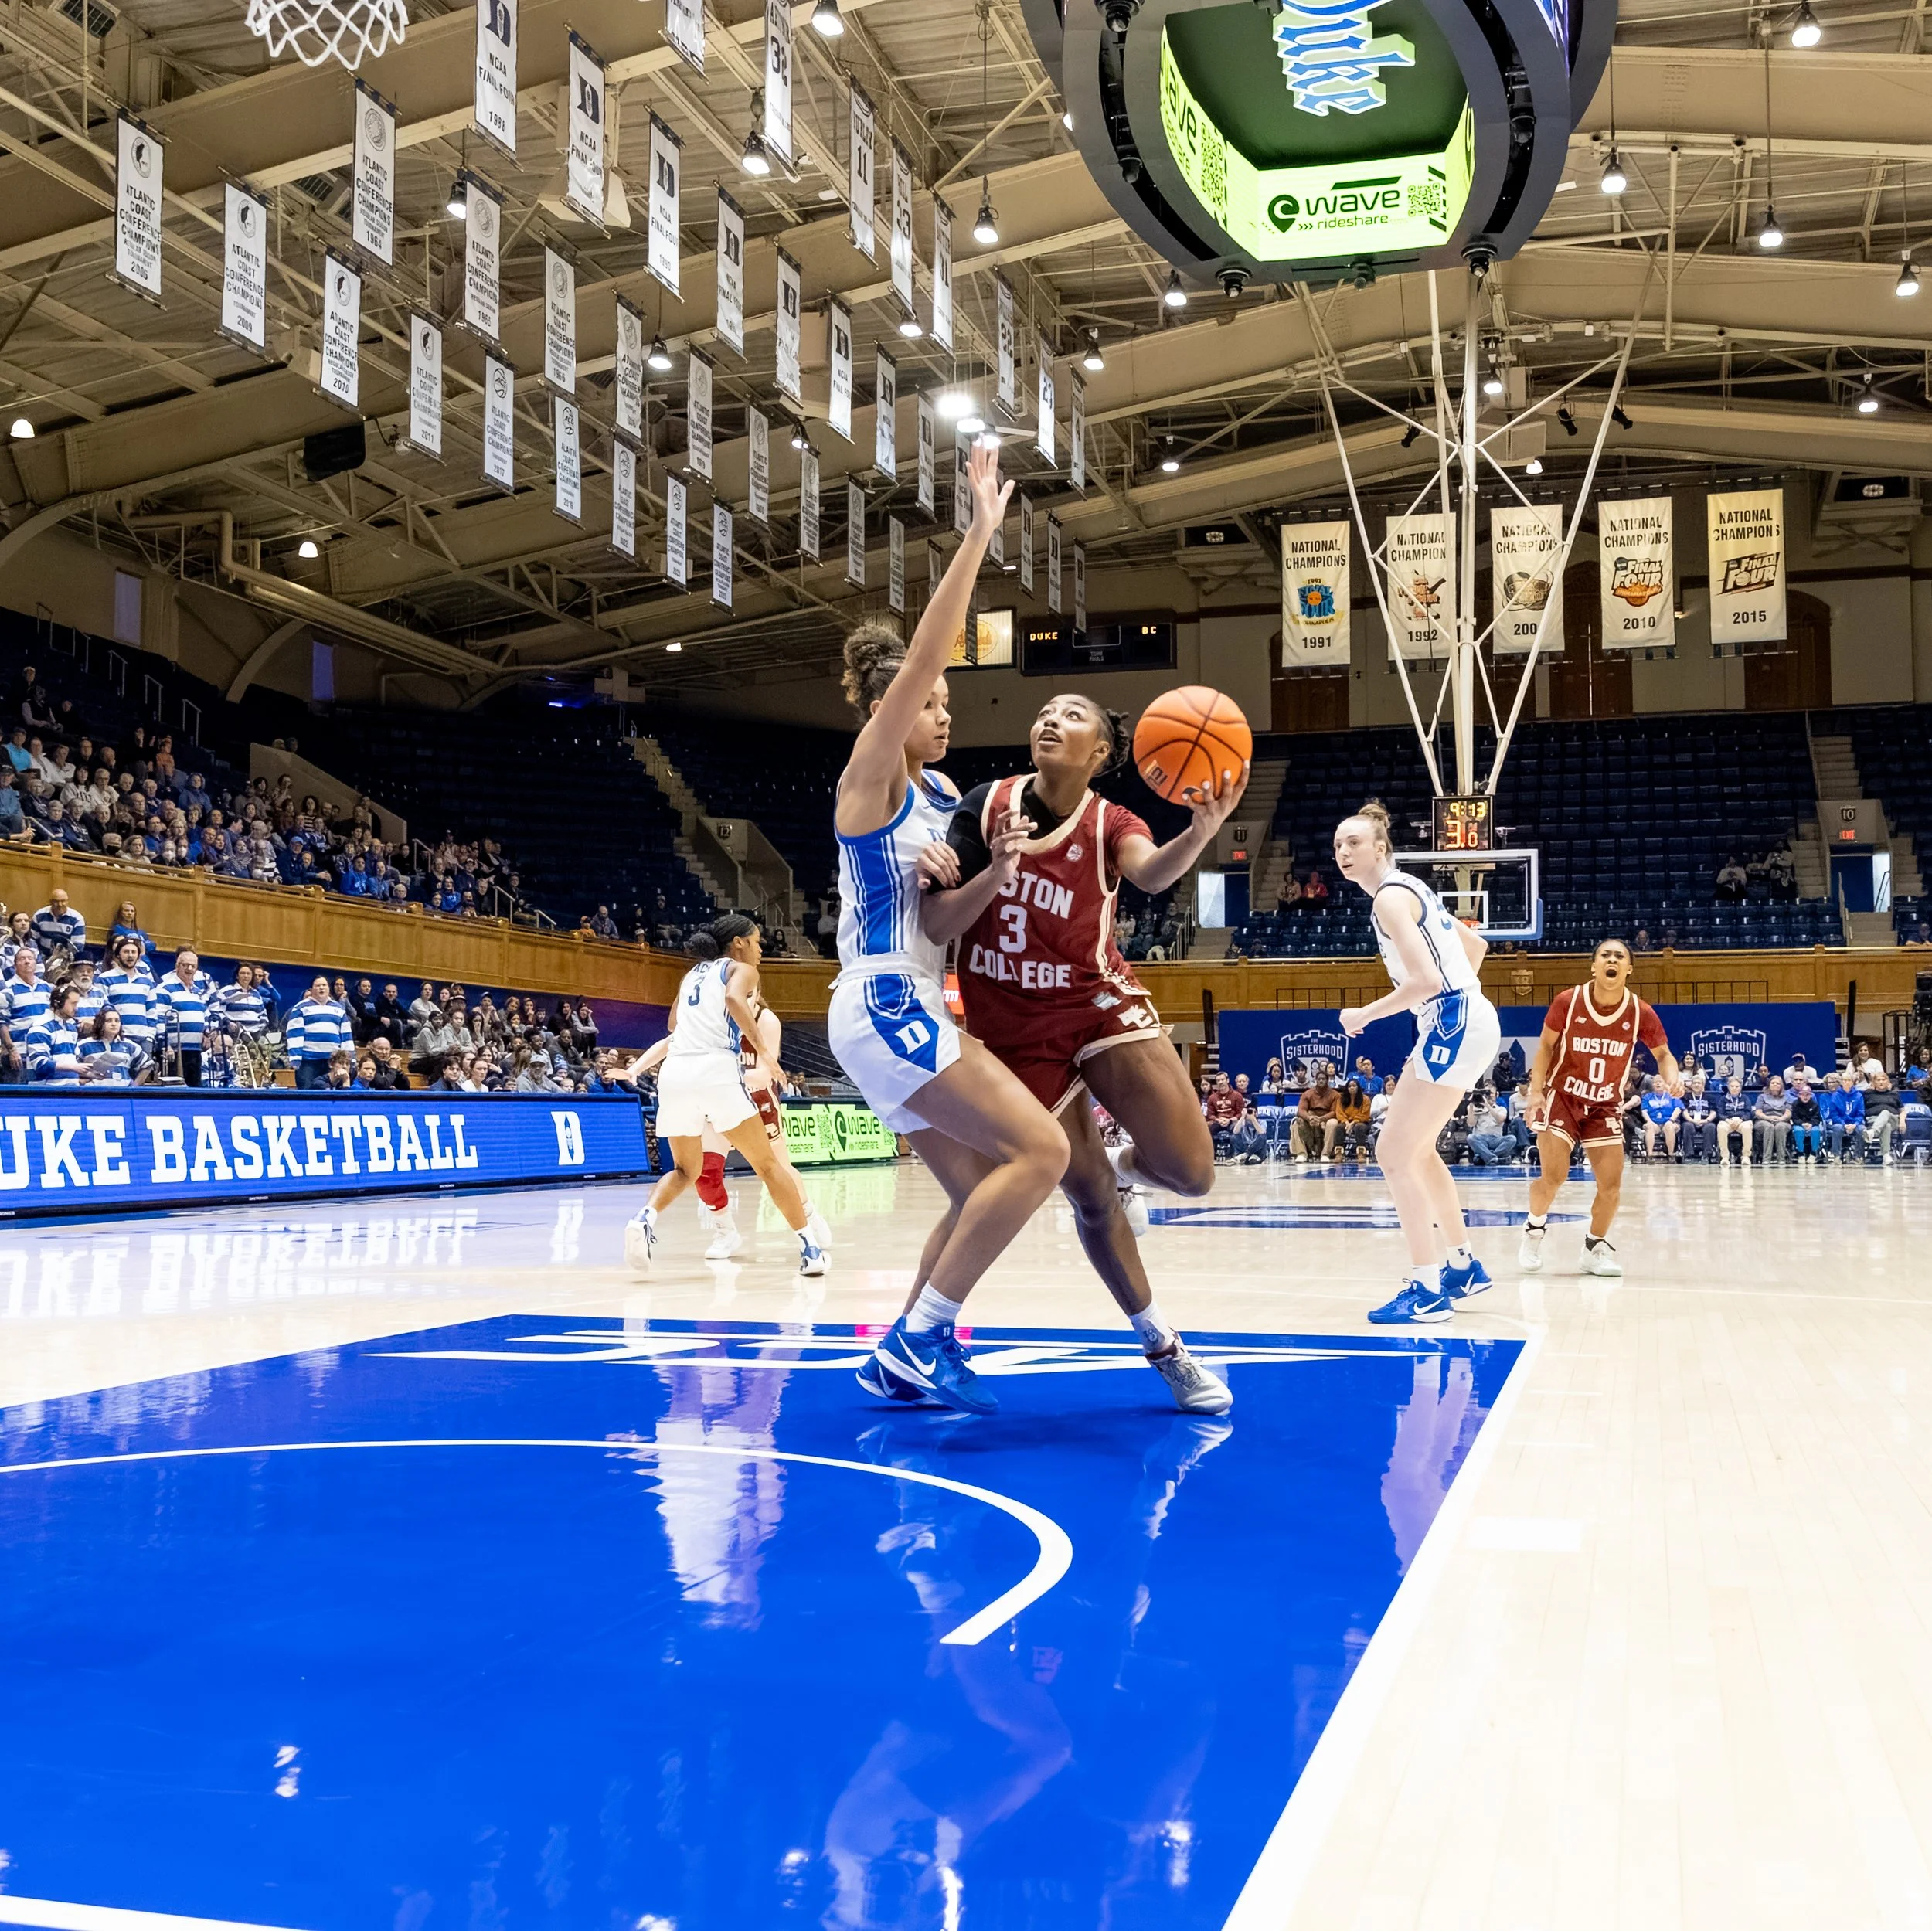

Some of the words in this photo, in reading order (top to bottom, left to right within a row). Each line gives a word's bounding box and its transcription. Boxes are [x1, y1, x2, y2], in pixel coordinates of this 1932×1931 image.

[490, 53, 506, 76] NCAA
[1272, 0, 1415, 116] uke
[479, 66, 498, 91] FINAL
[580, 131, 596, 152] NCAA
[572, 144, 587, 165] FINAL
[363, 154, 387, 181] ATLANTIC
[857, 146, 868, 185] 11
[366, 170, 384, 192] COAST
[127, 183, 155, 210] ATLANTIC
[356, 178, 392, 213] CONFERENCE
[131, 201, 151, 222] COAST
[358, 192, 390, 226] CHAMPIONS
[120, 209, 161, 242] CONFERENCE
[1318, 214, 1388, 229] rideshare
[122, 223, 158, 255] CHAMPIONS
[367, 231, 382, 249] 1964
[233, 244, 260, 267] ATLANTIC
[472, 240, 494, 263] ATLANTIC
[238, 260, 255, 278] COAST
[476, 256, 491, 273] COAST
[226, 267, 264, 297] CONFERENCE
[226, 281, 262, 309] CHAMPIONS
[553, 315, 566, 332] COAST
[333, 378, 349, 393] 2010
[488, 425, 512, 445] CONFERENC
[1610, 516, 1662, 532] NATIONAL
[1719, 508, 1772, 524] NATIONAL
[1604, 532, 1668, 548] CHAMPIONS
[1713, 525, 1780, 541] CHAMPIONS
[1292, 539, 1340, 553] NATIONAL
[1391, 548, 1446, 561] CHAMPION
[1286, 555, 1346, 569] CHAMPIONS
[1627, 560, 1663, 574] FINAL
[1741, 556, 1777, 572] FINAL
[1613, 571, 1663, 590] FOUR
[1623, 617, 1655, 630] 2010
[1733, 610, 1766, 624] 2015
[1030, 631, 1058, 641] DUKE
[1408, 629, 1437, 642] 1992
[1513, 623, 1539, 635] 200
[1302, 637, 1332, 648] 1991
[1450, 801, 1486, 818] 9:13
[1842, 809, 1854, 820] 10
[720, 825, 730, 837] 12
[1446, 820, 1478, 848] 3.0
[998, 870, 1074, 920] STON
[999, 904, 1028, 954] 3
[894, 1020, 930, 1055] D
[1573, 1036, 1628, 1057] BOSTON
[1287, 1044, 1343, 1059] SISTERHOOD
[1428, 1045, 1451, 1065] D
[1698, 1041, 1760, 1057] SISTERHOOD
[1588, 1057, 1606, 1084] 0
[0, 1116, 131, 1190] UKE
[146, 1114, 478, 1183] BASKETBALL
